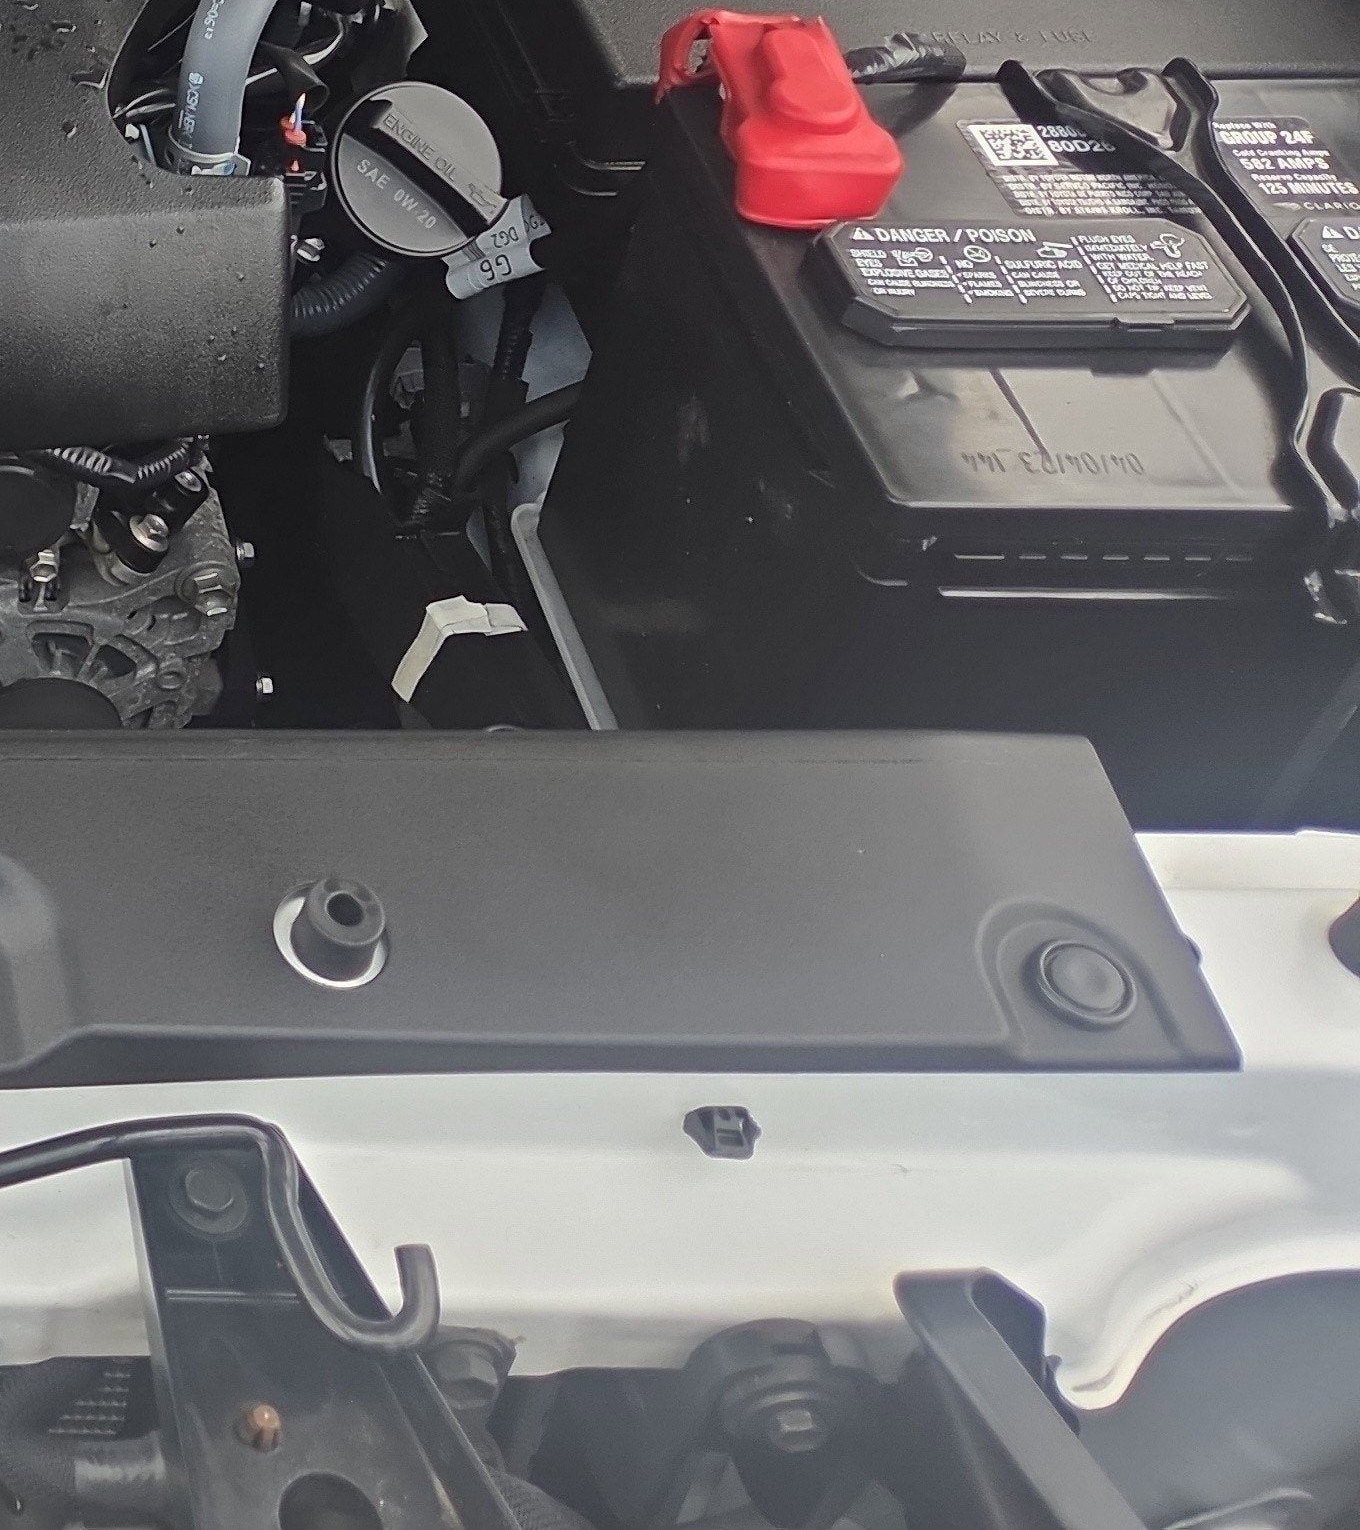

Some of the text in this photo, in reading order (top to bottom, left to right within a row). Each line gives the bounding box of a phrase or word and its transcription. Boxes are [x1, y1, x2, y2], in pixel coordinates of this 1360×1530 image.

[1212, 122, 1252, 130] Replace
[1218, 130, 1316, 145] GROUP 24F
[383, 113, 457, 181] ENGINE OIL
[1232, 149, 1331, 158] Cold Cracking Amps
[1239, 158, 1331, 170] 582 AMPS
[356, 159, 391, 190] SAE
[1250, 173, 1338, 182] Reserve Capacity
[1258, 182, 1360, 195] 125 MINUTES
[874, 227, 1037, 243] DANGER / POISON
[1078, 235, 1136, 244] FLUSH EYES
[849, 248, 887, 258] SHIELD
[1084, 244, 1148, 253] IMMEDIATELY
[1090, 253, 1116, 262] WITH
[479, 252, 513, 282] G6
[855, 258, 882, 268] EYES
[954, 259, 974, 269] NO
[1004, 259, 1084, 270] SULFURIC ACID
[1095, 260, 1210, 271] GET MEDICAL HELP FAST
[860, 268, 950, 278] EXPLOSIVE GASES
[1011, 271, 1060, 279] CAN CAUSE
